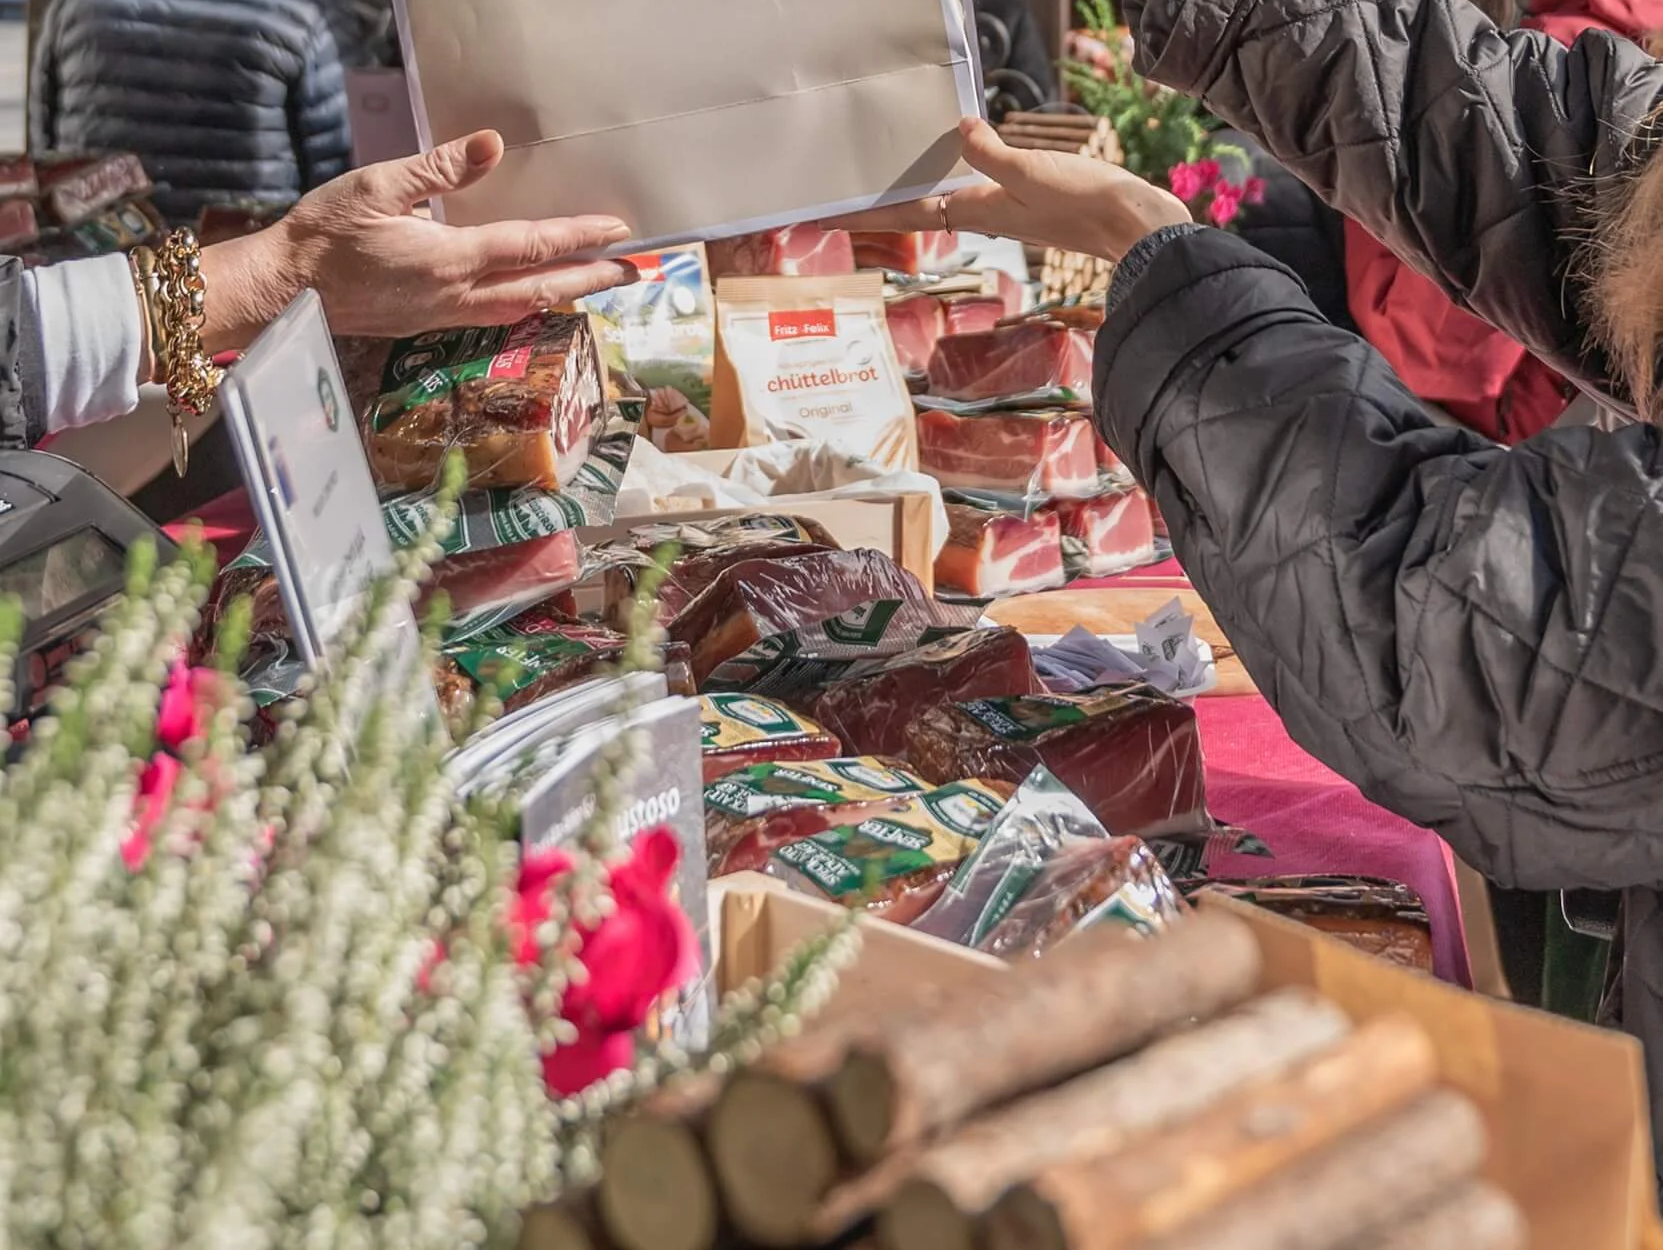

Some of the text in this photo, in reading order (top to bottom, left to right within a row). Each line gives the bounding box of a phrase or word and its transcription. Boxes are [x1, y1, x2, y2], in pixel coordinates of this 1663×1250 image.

[774, 322, 831, 335] Fritz Felix
[764, 366, 879, 393] chüttelbrot
[799, 401, 853, 418] Original
[617, 786, 681, 839] ustoso
[858, 820, 930, 850] SENFTER
